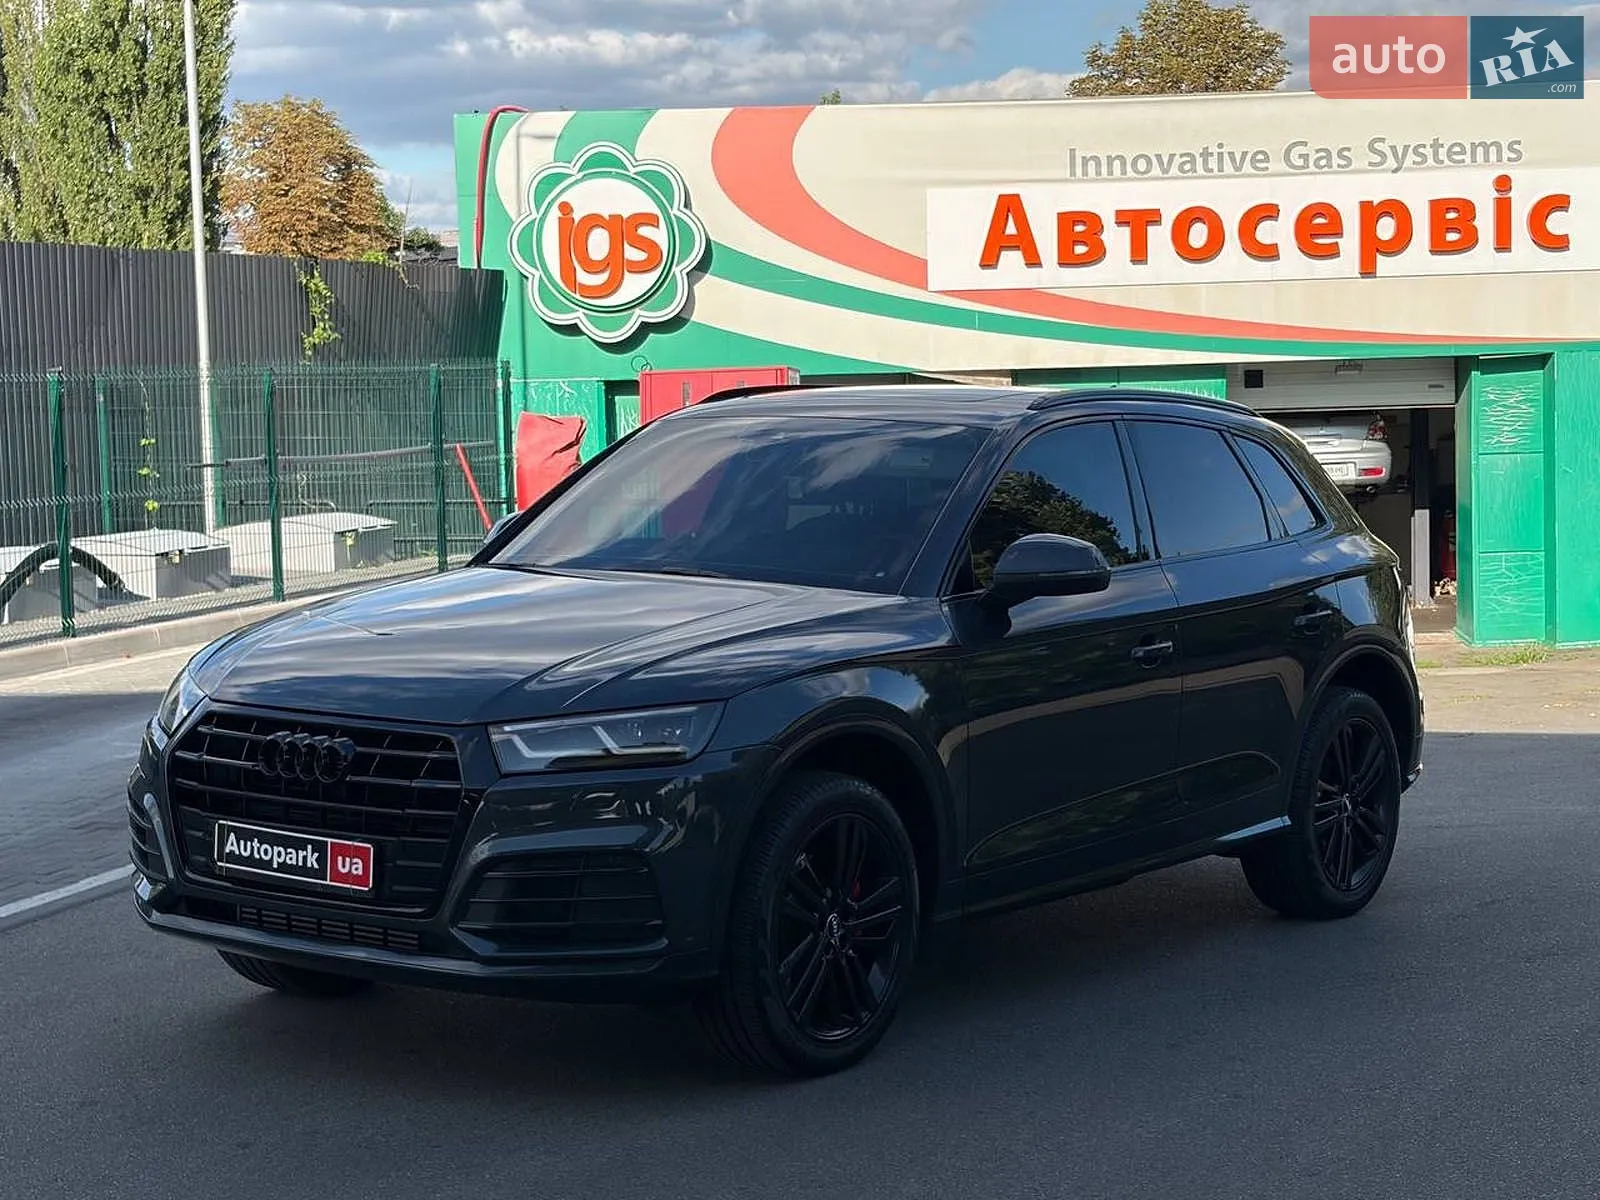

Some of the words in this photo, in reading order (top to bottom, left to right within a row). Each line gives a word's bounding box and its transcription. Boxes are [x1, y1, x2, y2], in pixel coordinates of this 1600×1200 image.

[1068, 142, 1271, 178] Innovative
[1283, 139, 1353, 171] Gas
[1367, 136, 1523, 173] Systems
[558, 201, 663, 299] igs
[979, 174, 1572, 278] Автосервіс
[225, 832, 320, 869] Autopark
[337, 855, 363, 876] ua
